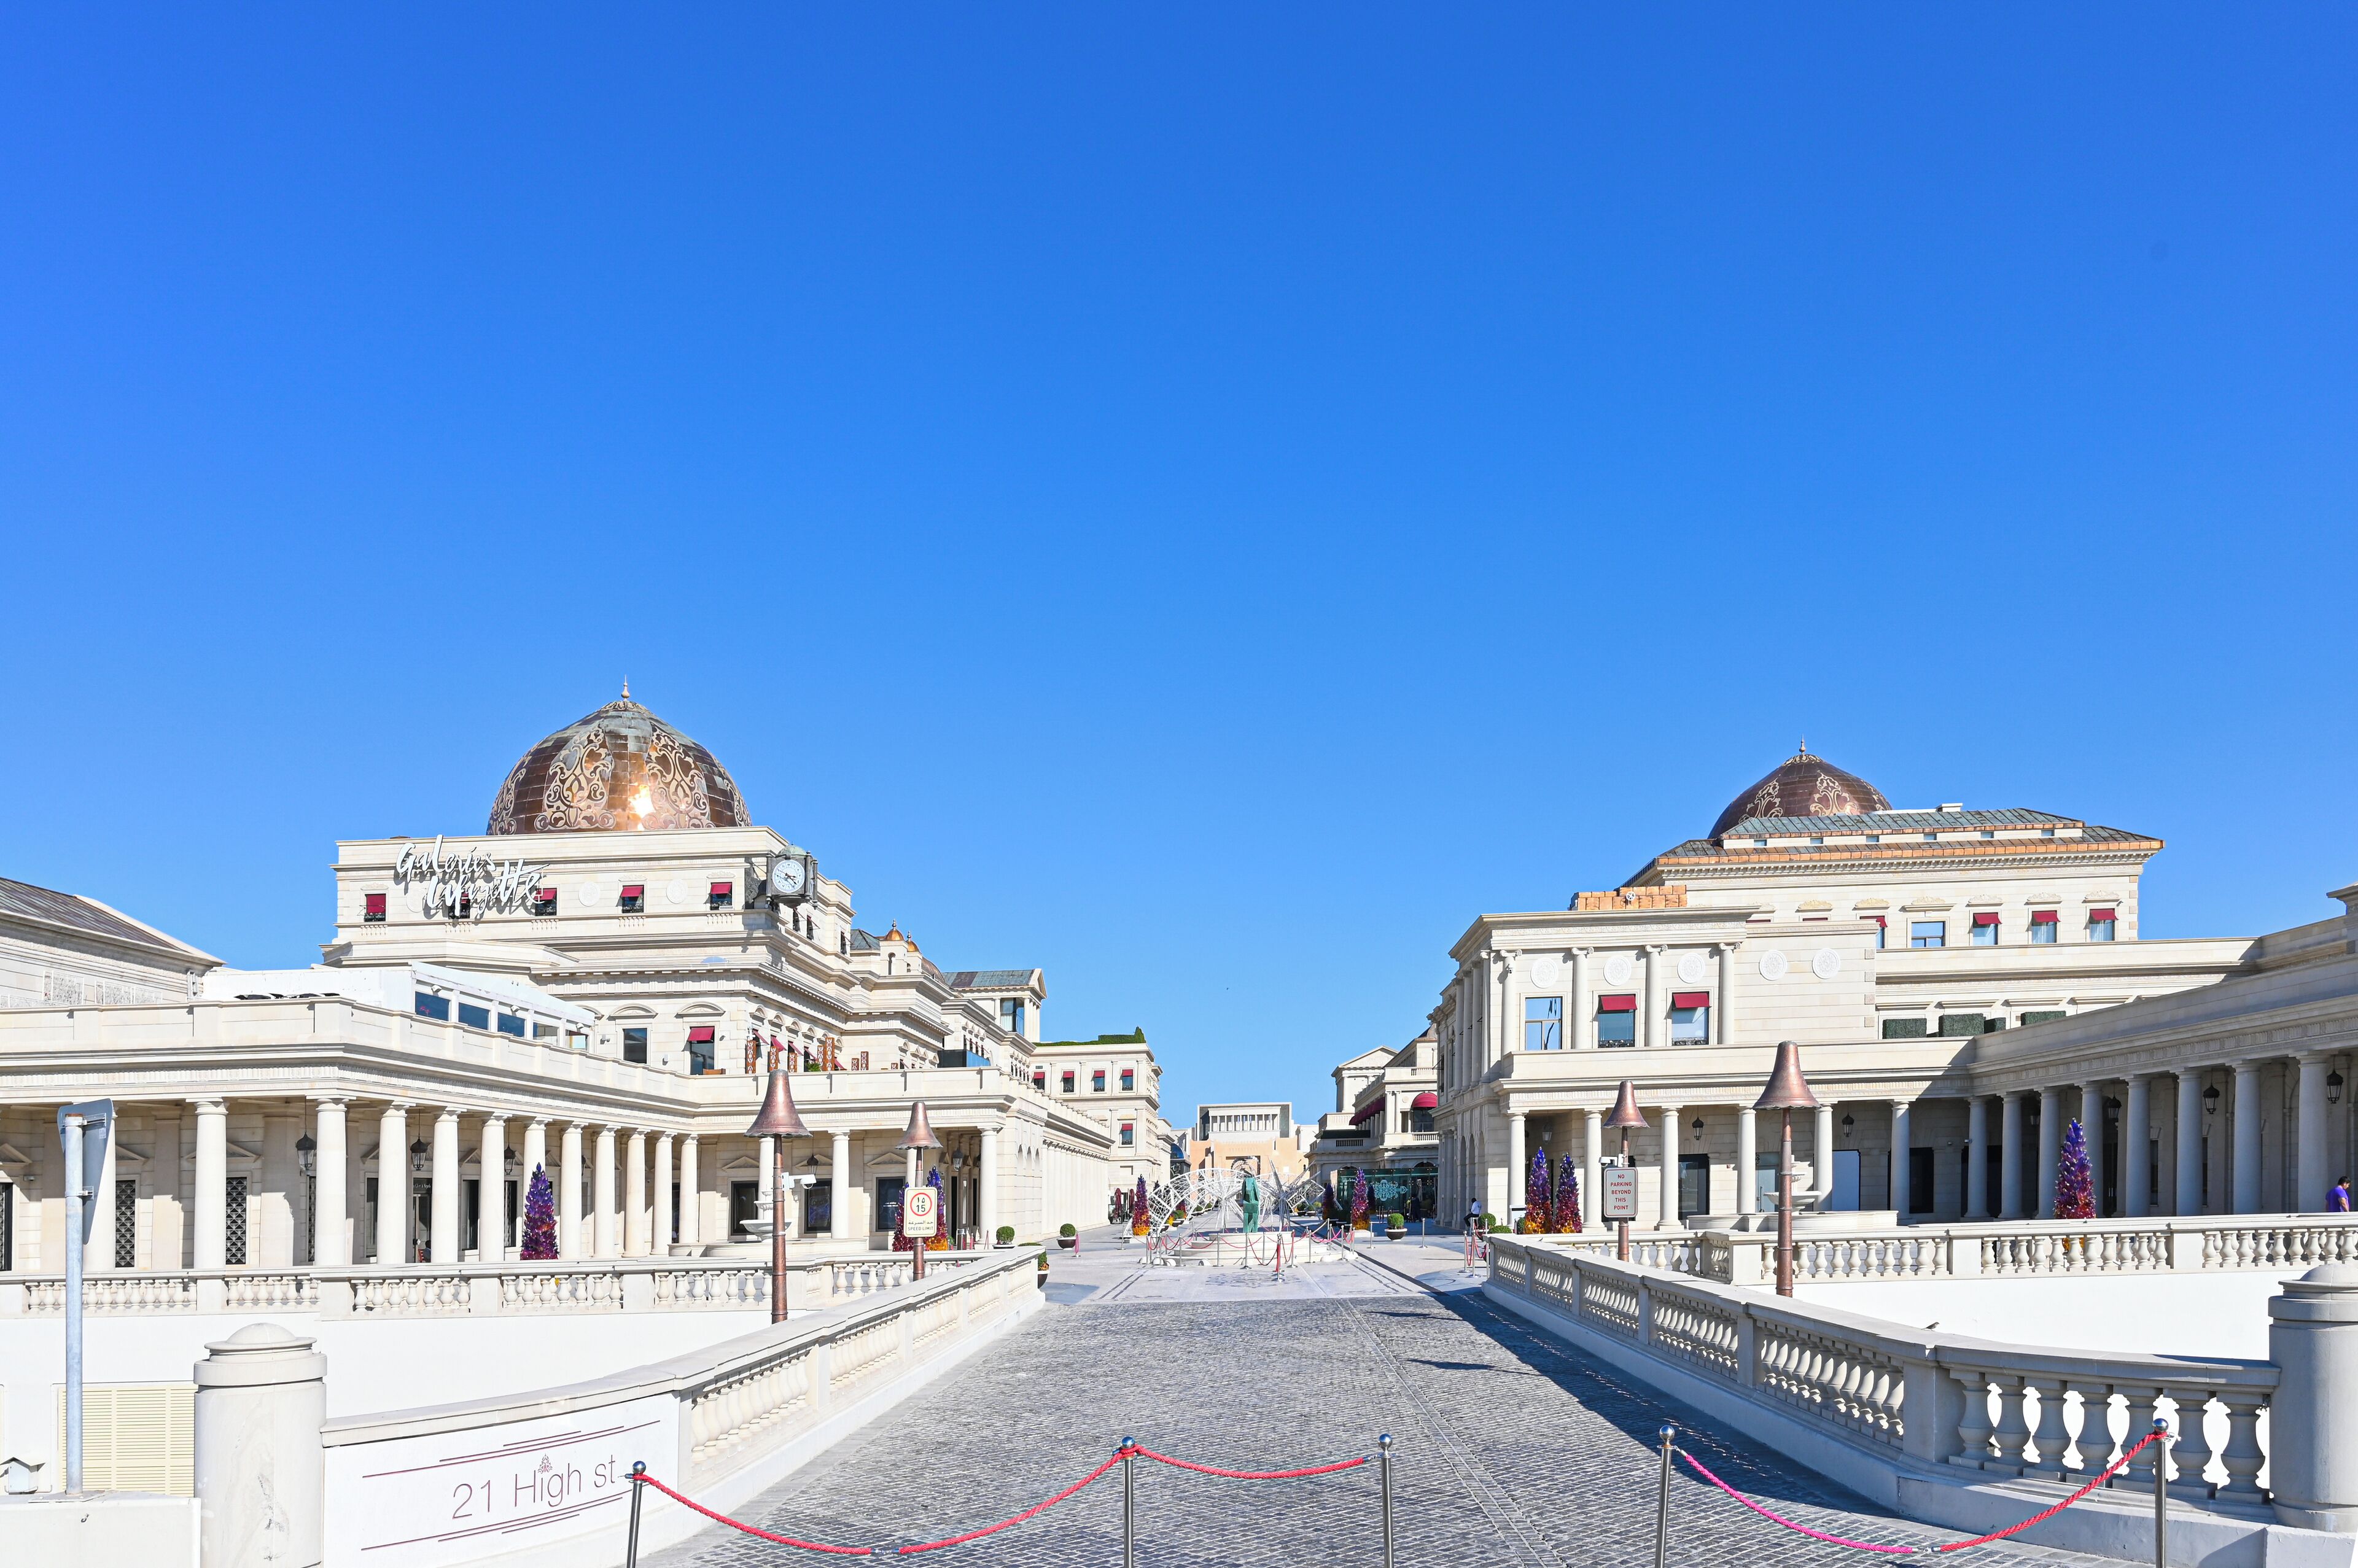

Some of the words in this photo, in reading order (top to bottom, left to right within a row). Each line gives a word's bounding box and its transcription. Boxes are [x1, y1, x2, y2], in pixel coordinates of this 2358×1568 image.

[395, 834, 497, 882] Galeries
[426, 859, 550, 917] Lafayette
[452, 1480, 491, 1519] 21
[515, 1462, 582, 1507] High
[594, 1454, 617, 1488] st
